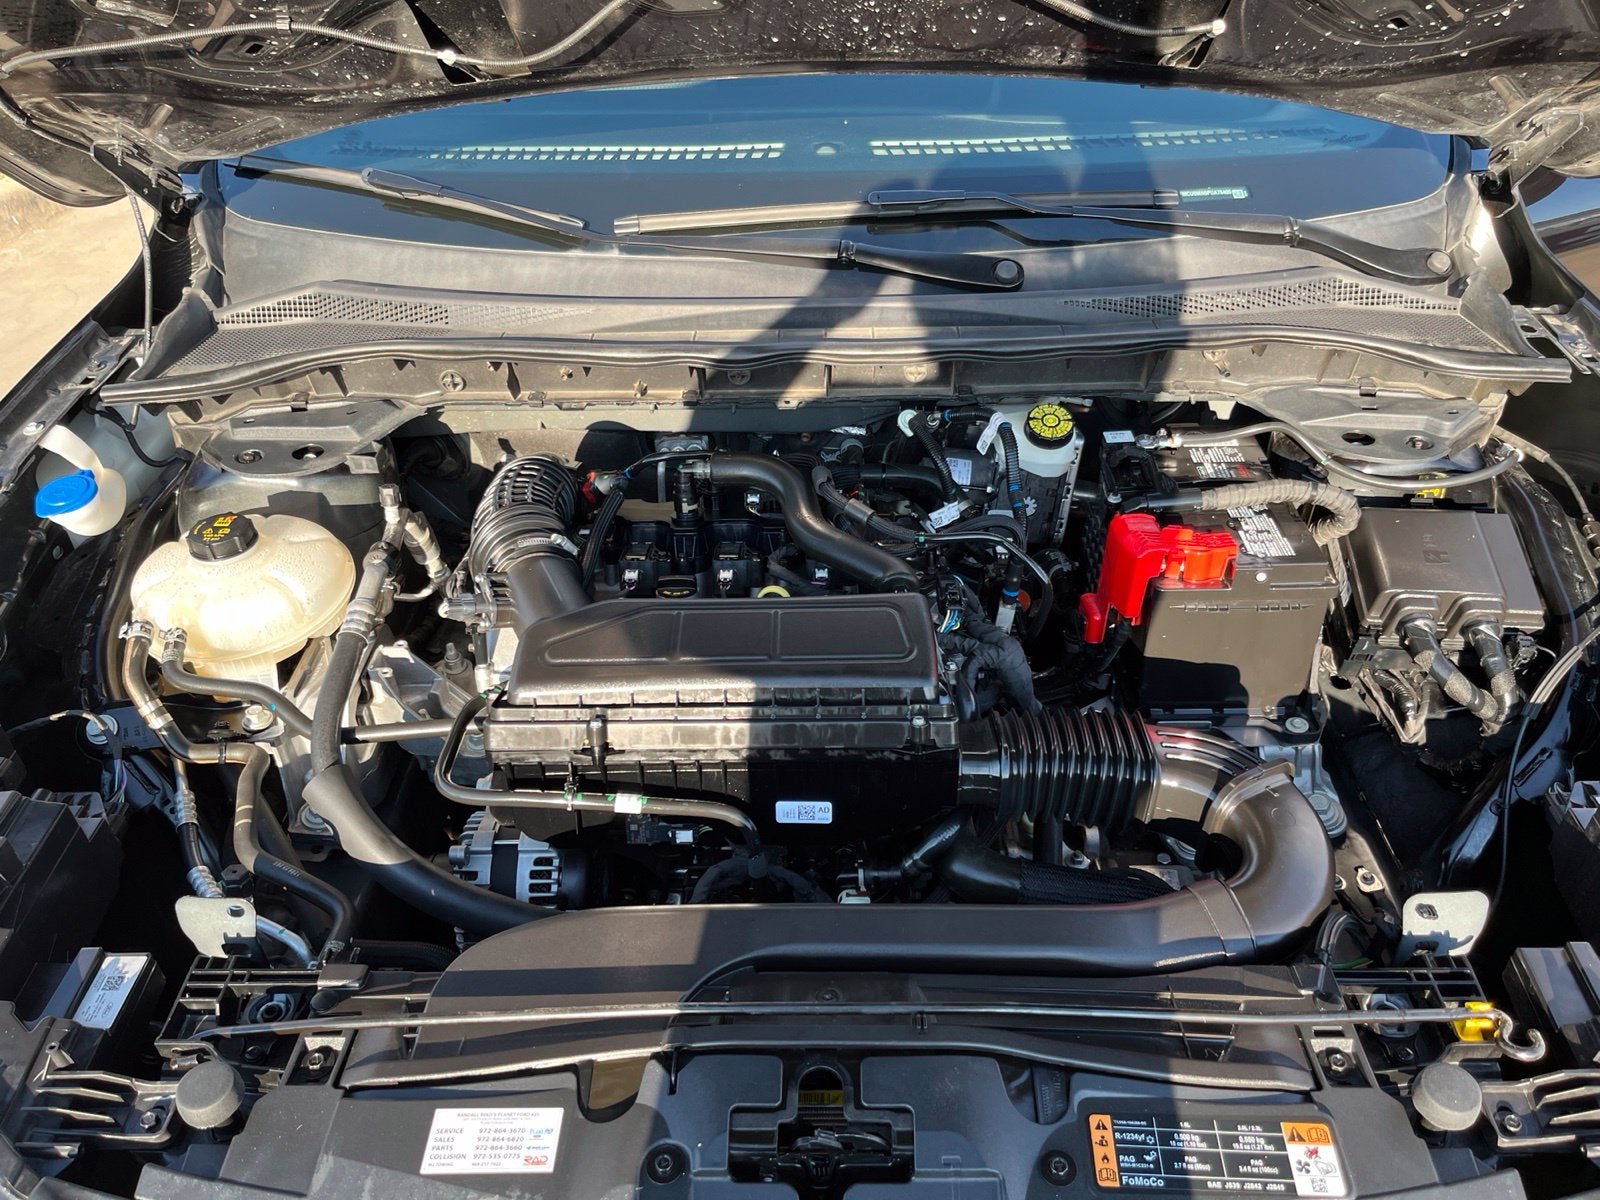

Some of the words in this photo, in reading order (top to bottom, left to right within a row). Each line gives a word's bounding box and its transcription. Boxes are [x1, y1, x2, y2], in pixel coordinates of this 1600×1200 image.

[818, 806, 830, 814] AD
[1114, 1132, 1145, 1142] R-1234yf
[1190, 1134, 1200, 1142] kg
[1255, 1136, 1265, 1144] kg
[1121, 1175, 1164, 1186] FoMoCo
[1207, 1181, 1222, 1189] SAE
